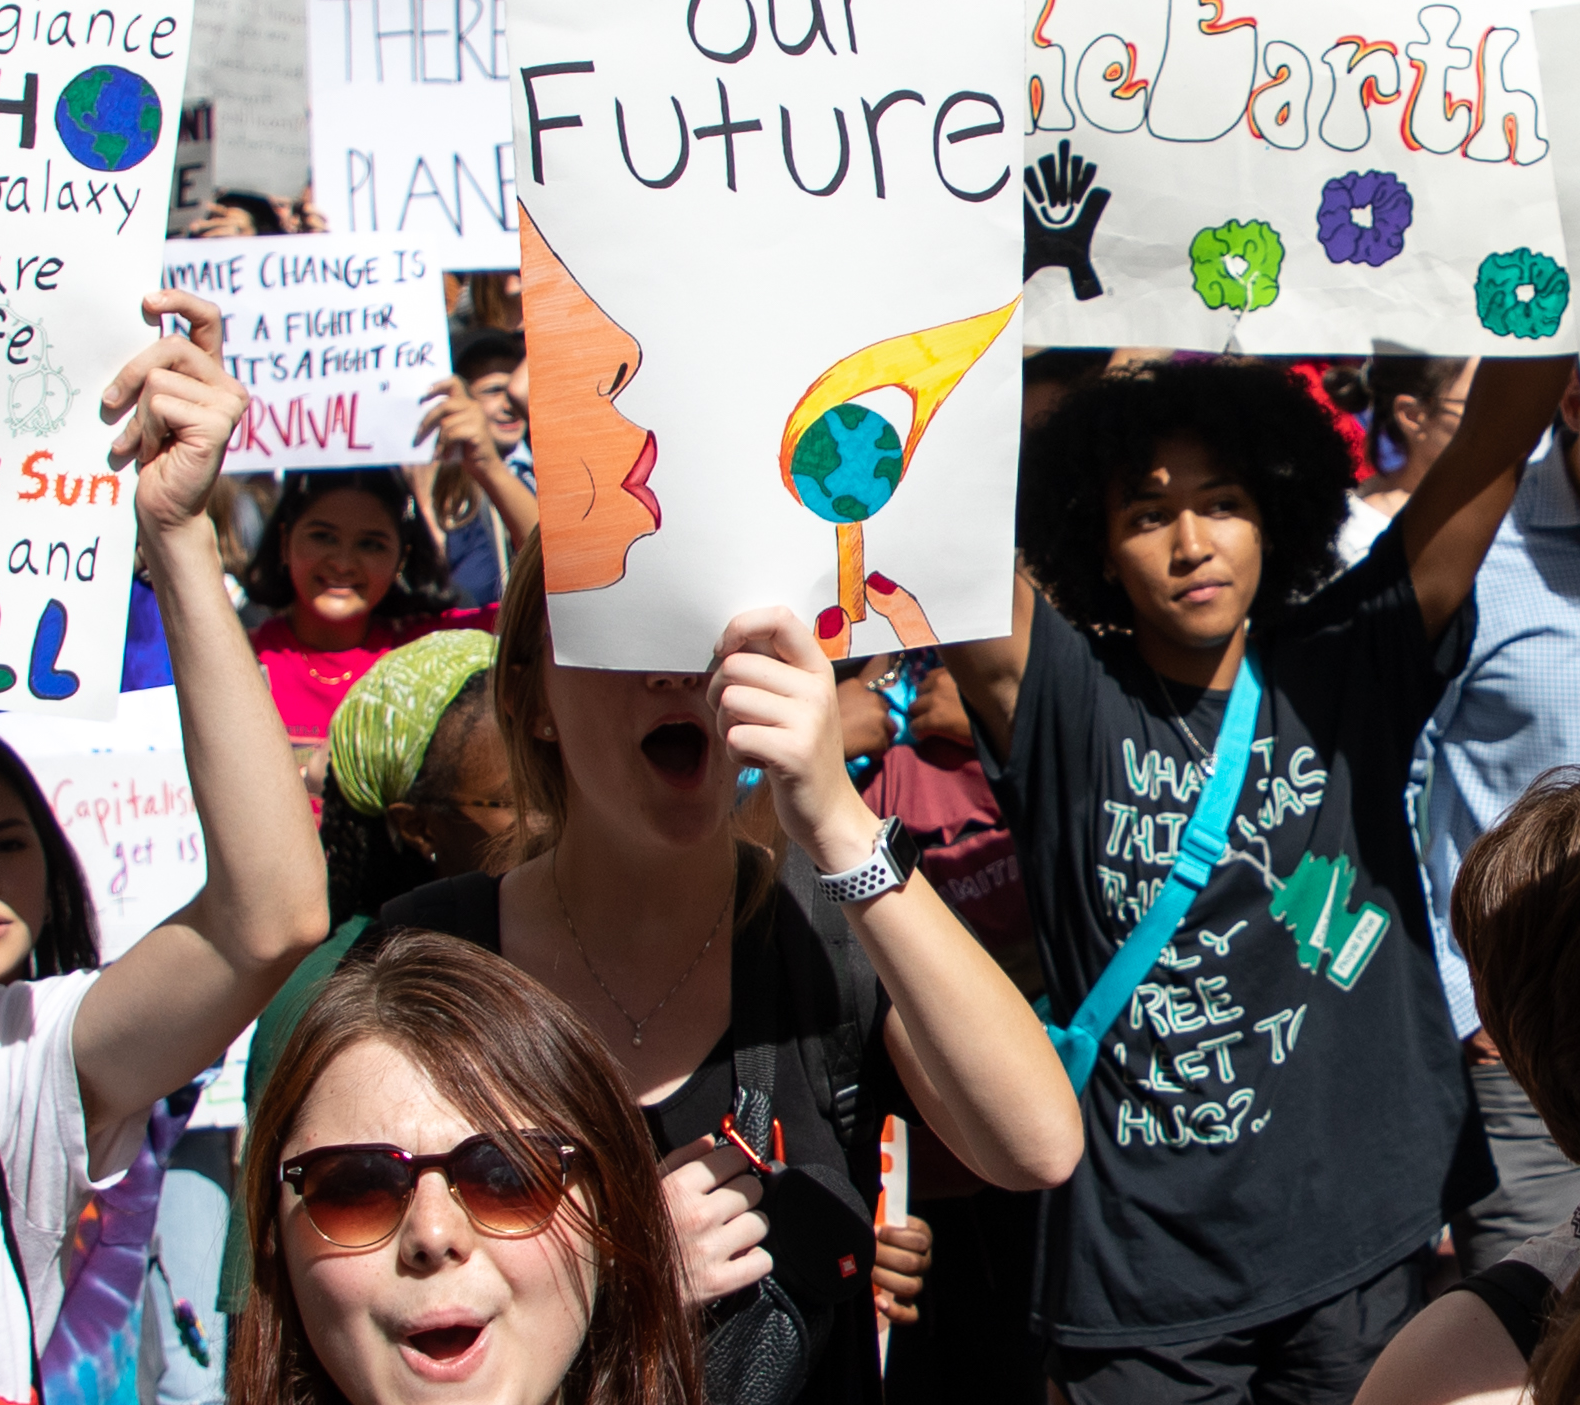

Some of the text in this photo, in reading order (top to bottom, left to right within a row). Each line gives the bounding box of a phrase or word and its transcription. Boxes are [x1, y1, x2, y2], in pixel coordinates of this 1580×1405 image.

[520, 60, 1011, 203] Future
[259, 252, 380, 289] CHANGE
[393, 249, 426, 283] IS
[253, 314, 271, 341] A
[286, 308, 358, 343] FIGHT
[363, 303, 398, 331] FOR
[293, 348, 313, 379] A
[321, 344, 387, 377] FIGHT
[394, 341, 436, 368] FOR
[17, 449, 123, 507] Sun
[8, 525, 100, 583] and
[1129, 974, 1245, 1037] REE
